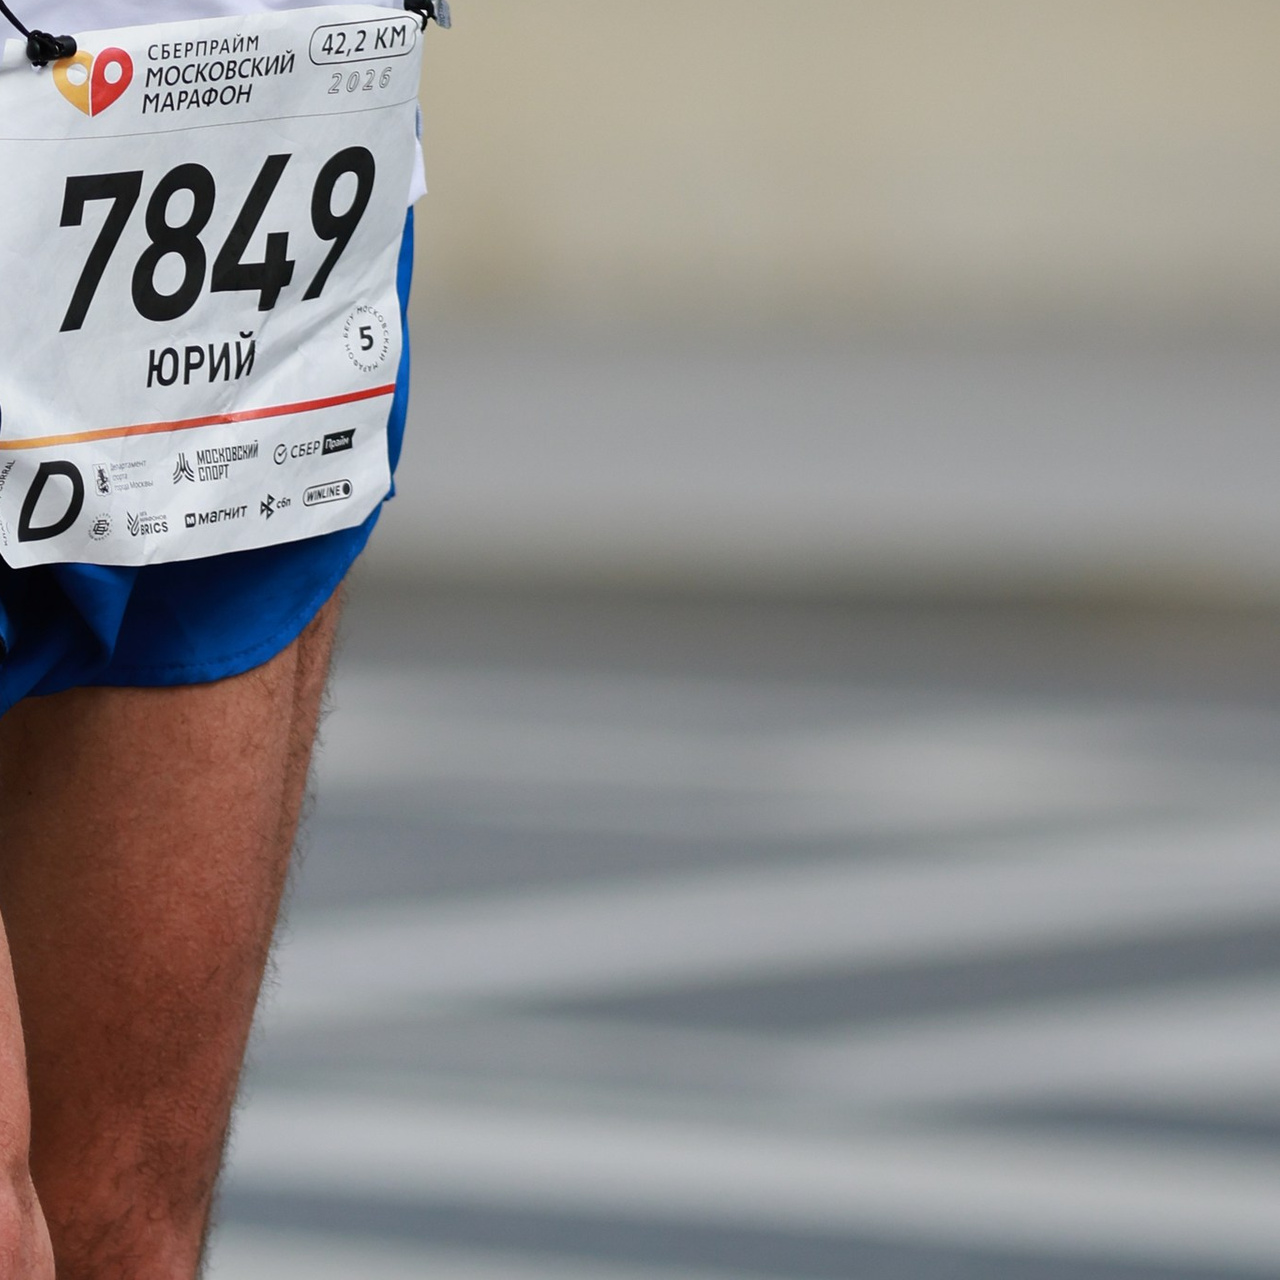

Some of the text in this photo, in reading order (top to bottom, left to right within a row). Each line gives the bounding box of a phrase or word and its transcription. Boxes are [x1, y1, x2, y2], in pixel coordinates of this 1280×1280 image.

[148, 34, 259, 61] СБЕРПРАЙМ
[321, 29, 367, 57] 42,2
[145, 50, 295, 88] МОСКОВСКИЙ
[328, 66, 392, 95] 2026
[142, 83, 253, 114] МАРАФОН
[59, 146, 376, 333] 7849
[359, 325, 374, 351] 5
[146, 331, 256, 389] ЮРИЙ
[196, 440, 259, 465] МОСКОВСКИЙ
[291, 440, 320, 459] СБЕР
[198, 464, 230, 482] СПОРТ
[18, 460, 85, 543] D
[276, 497, 292, 509] сбп
[306, 484, 341, 502] WINLINE
[140, 521, 169, 535] BRICS
[198, 505, 248, 526] магнит
